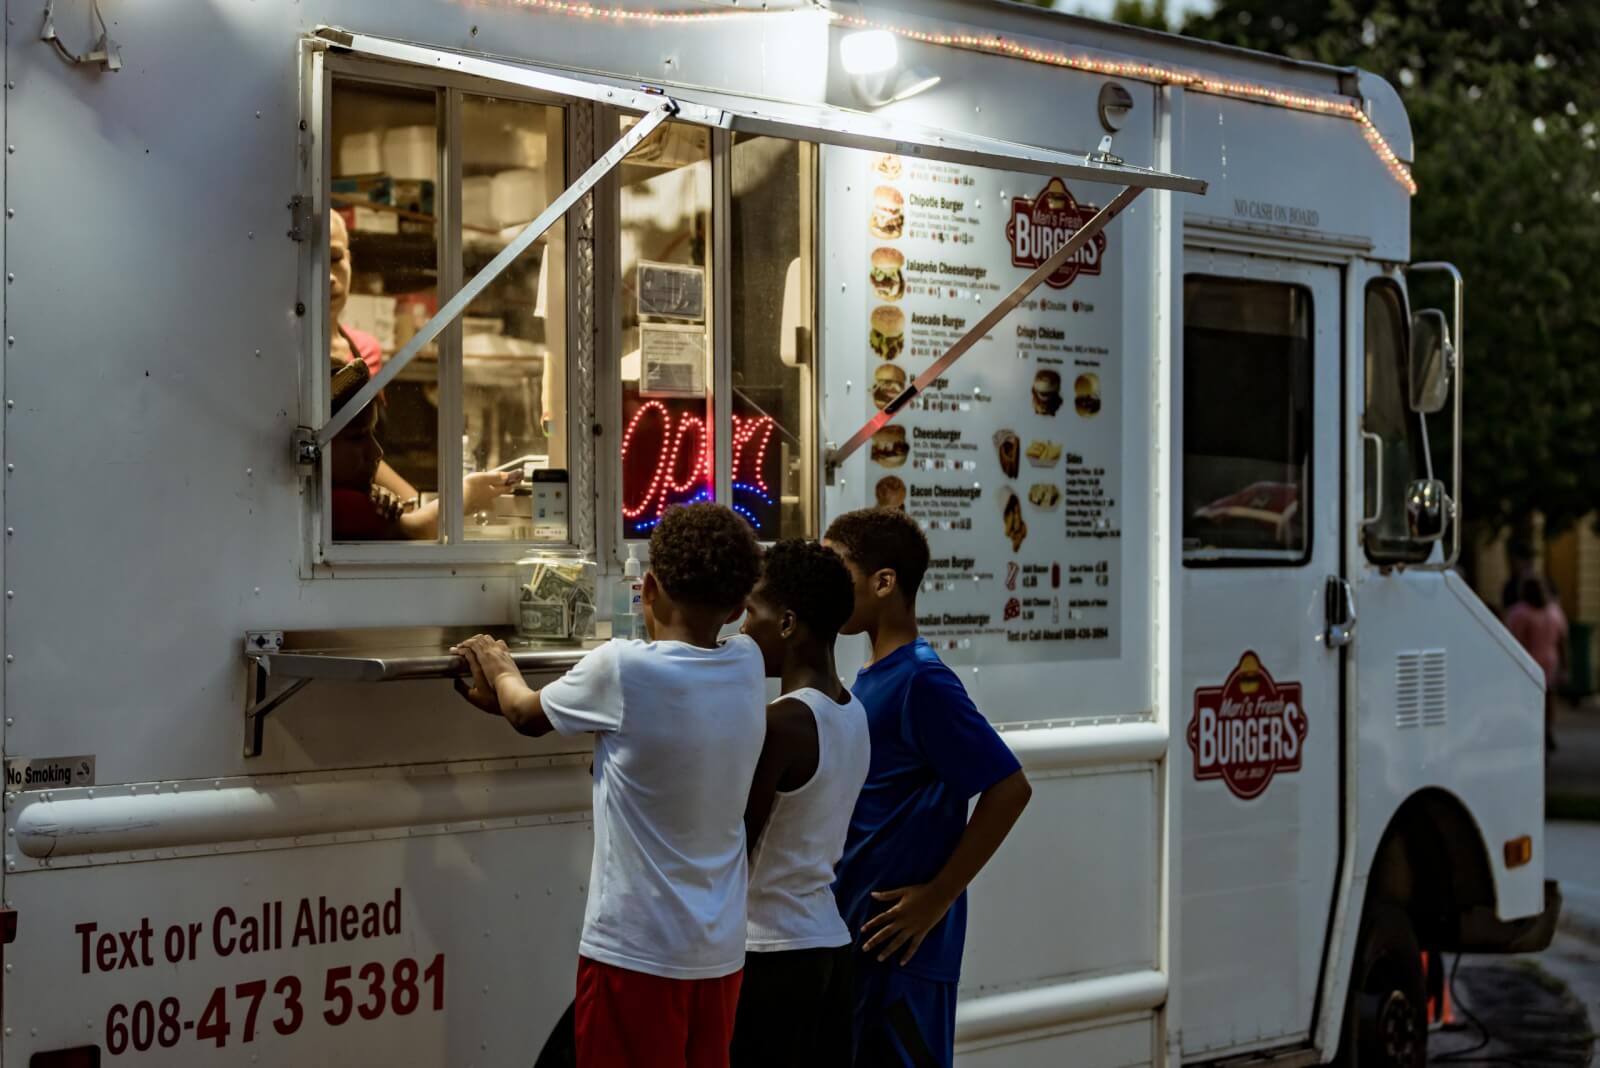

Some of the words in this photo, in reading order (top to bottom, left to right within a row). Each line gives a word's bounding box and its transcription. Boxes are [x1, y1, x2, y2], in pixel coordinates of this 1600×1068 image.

[909, 193, 938, 208] Chipotle
[940, 197, 963, 212] Burger
[939, 262, 986, 279] Cheeseburger
[912, 312, 940, 325] Avocado
[942, 314, 966, 330] Burger
[1017, 325, 1036, 340] Crispy
[1039, 327, 1065, 340] Chicken
[913, 426, 961, 443] Cheeseburger
[621, 399, 773, 517] Opn
[910, 485, 933, 497] Bacon
[934, 485, 982, 501] Cheeseburger
[952, 555, 976, 571] Burger
[943, 613, 990, 628] Cheeseburger
[1007, 630, 1020, 641] Text
[1021, 632, 1028, 641] or
[1029, 629, 1041, 641] Call
[1043, 629, 1063, 640] Ahead
[1200, 702, 1298, 768] BURGERS
[7, 767, 21, 784] No
[25, 763, 71, 785] Smoking
[75, 917, 154, 974] Text
[164, 921, 202, 964] or
[212, 901, 282, 957] Call
[292, 887, 402, 948] Ahead
[322, 953, 446, 1026] 5381
